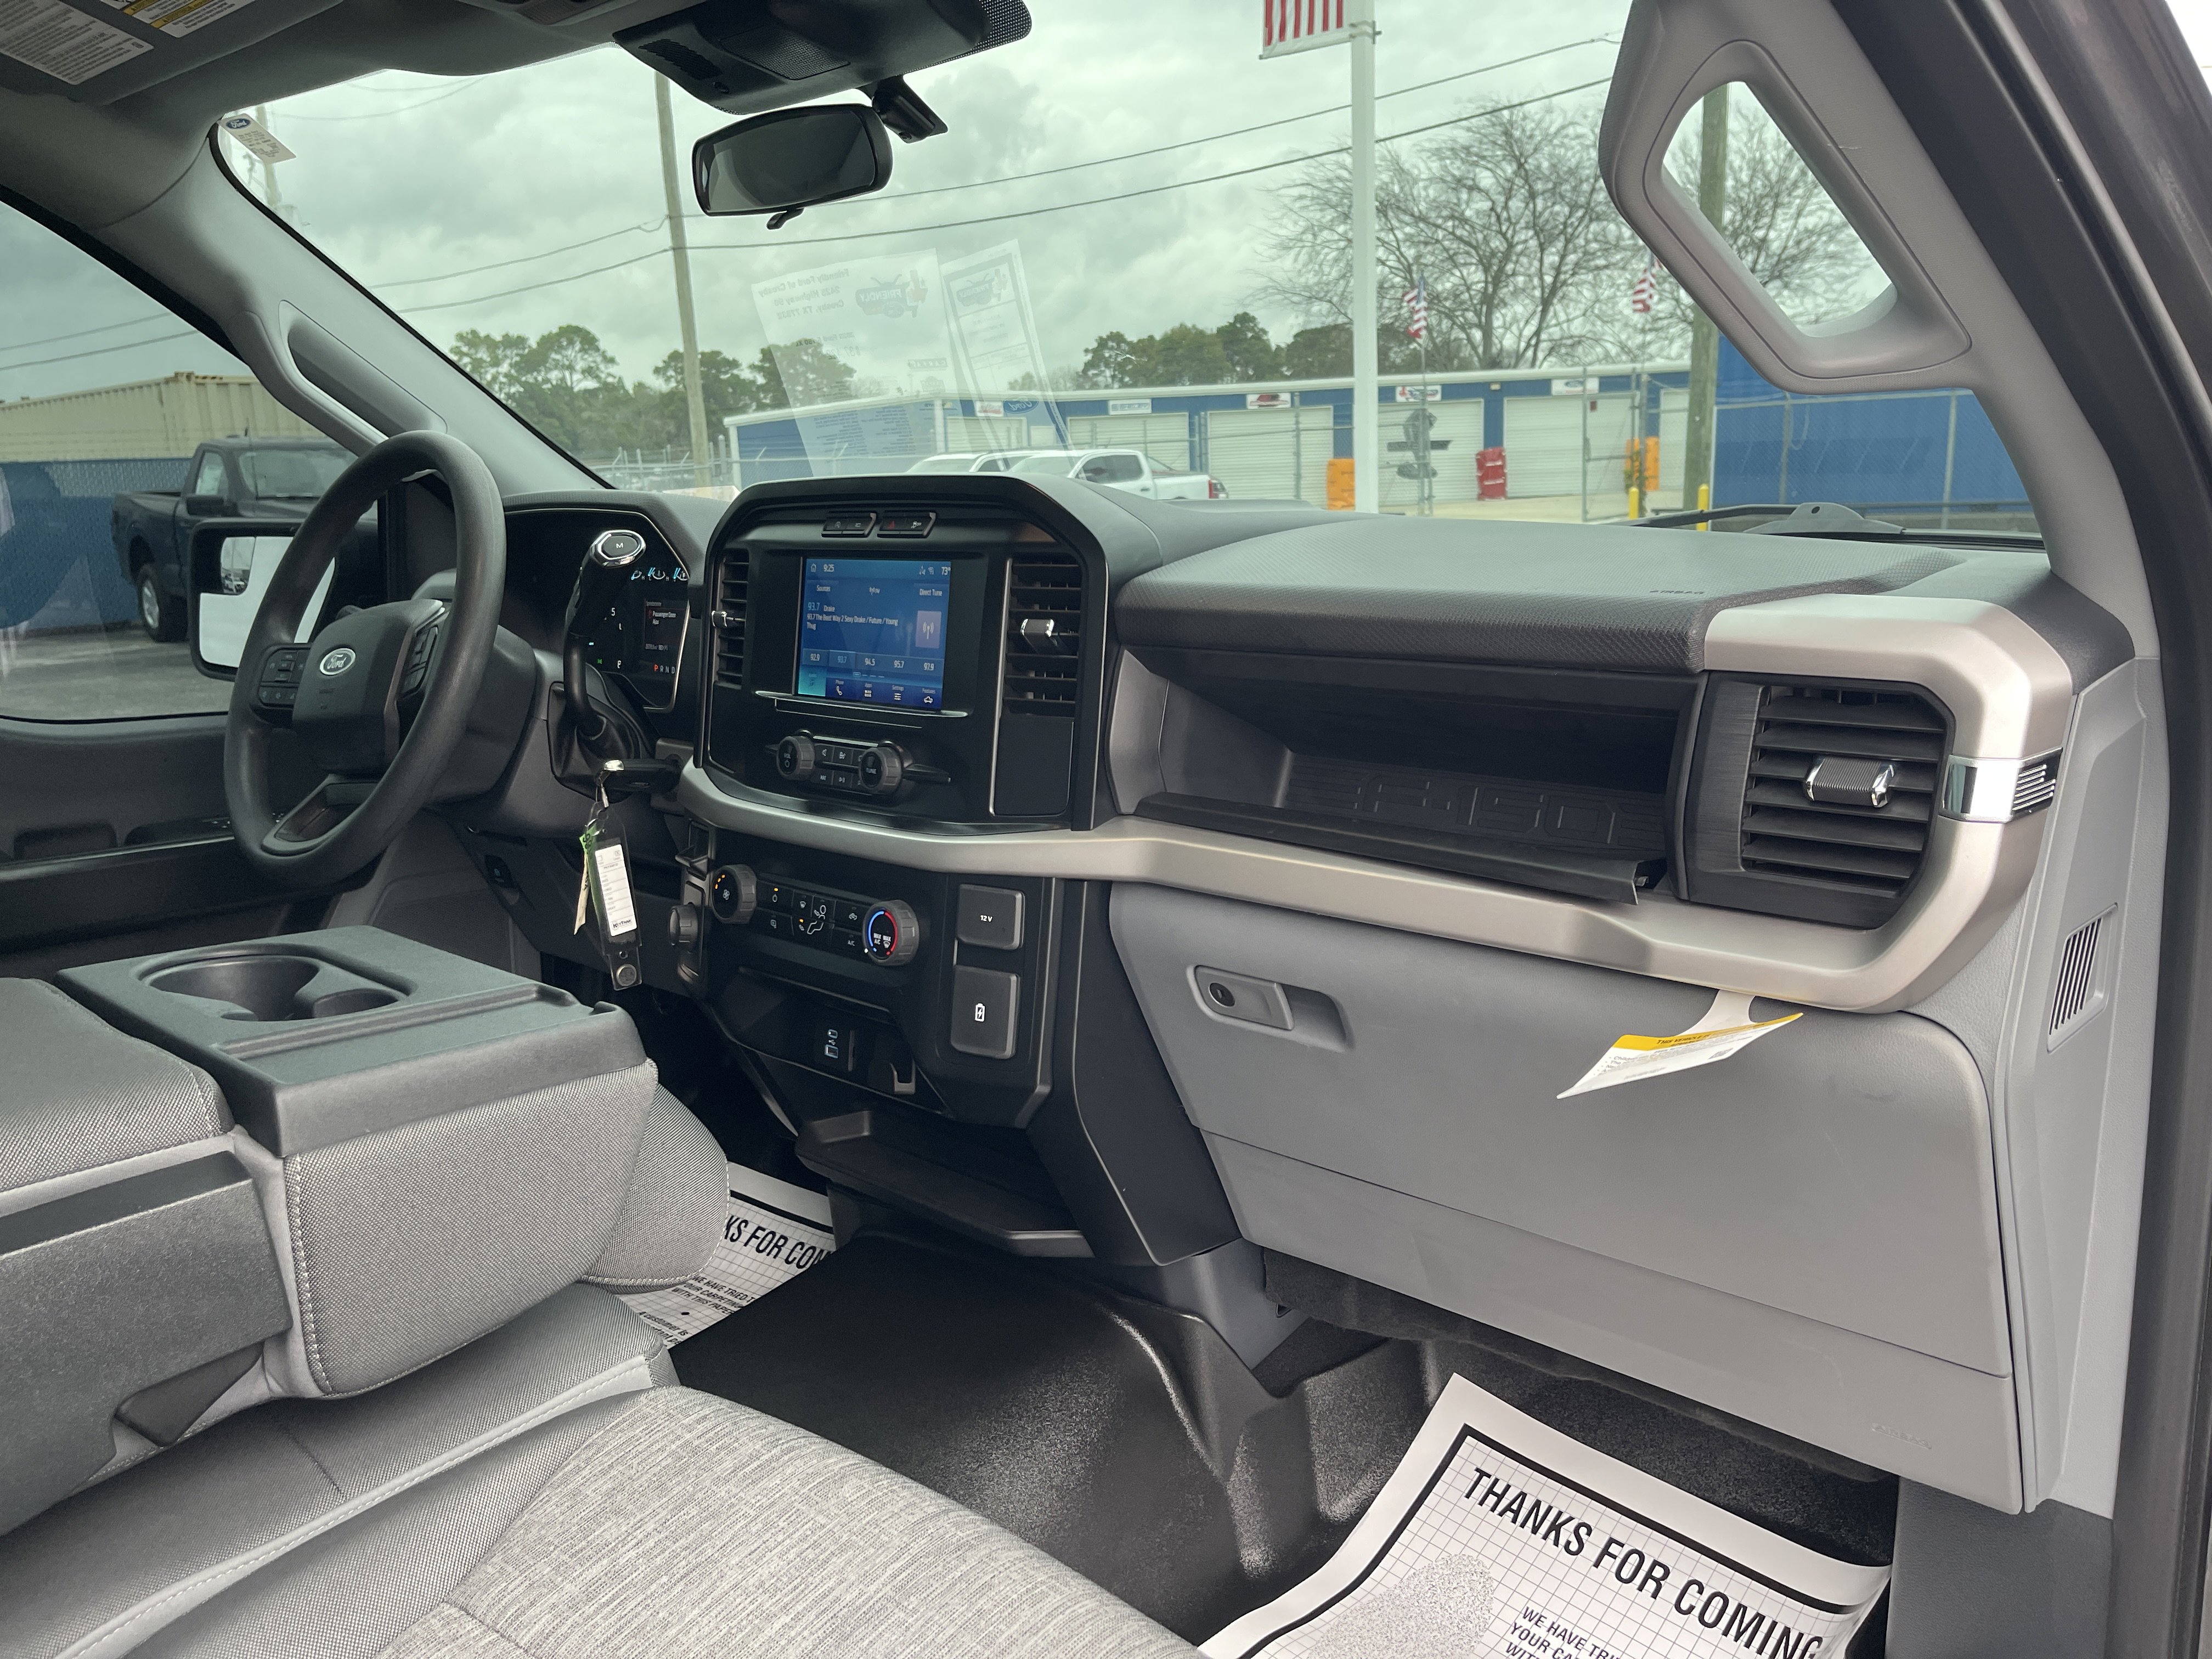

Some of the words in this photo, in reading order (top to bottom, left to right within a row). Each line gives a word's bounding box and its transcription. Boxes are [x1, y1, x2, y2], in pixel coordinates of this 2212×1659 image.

[230, 120, 247, 128] Ford
[823, 564, 834, 572] 9:25
[808, 602, 820, 611] 93.7
[806, 622, 816, 630] Thug
[885, 618, 899, 627] Young
[865, 658, 876, 666] 94.5
[894, 660, 905, 668] 95.7
[923, 662, 934, 671] 97.9
[1362, 774, 1616, 844] F-150
[743, 1226, 789, 1259] FOR
[672, 1287, 693, 1299] WITH
[691, 1295, 712, 1305] THIS
[703, 1278, 727, 1291] HAVE
[726, 1288, 748, 1302] TRIED
[644, 1314, 680, 1331] customer
[1874, 1423, 1931, 1448] AIRBAG
[1464, 1468, 1592, 1556] THANKS
[1592, 1537, 1671, 1600] FOR
[1673, 1579, 1824, 1659] COMING
[1522, 1606, 1547, 1628] WE
[1546, 1621, 1587, 1651] HAVE
[1510, 1622, 1550, 1654] YOUR
